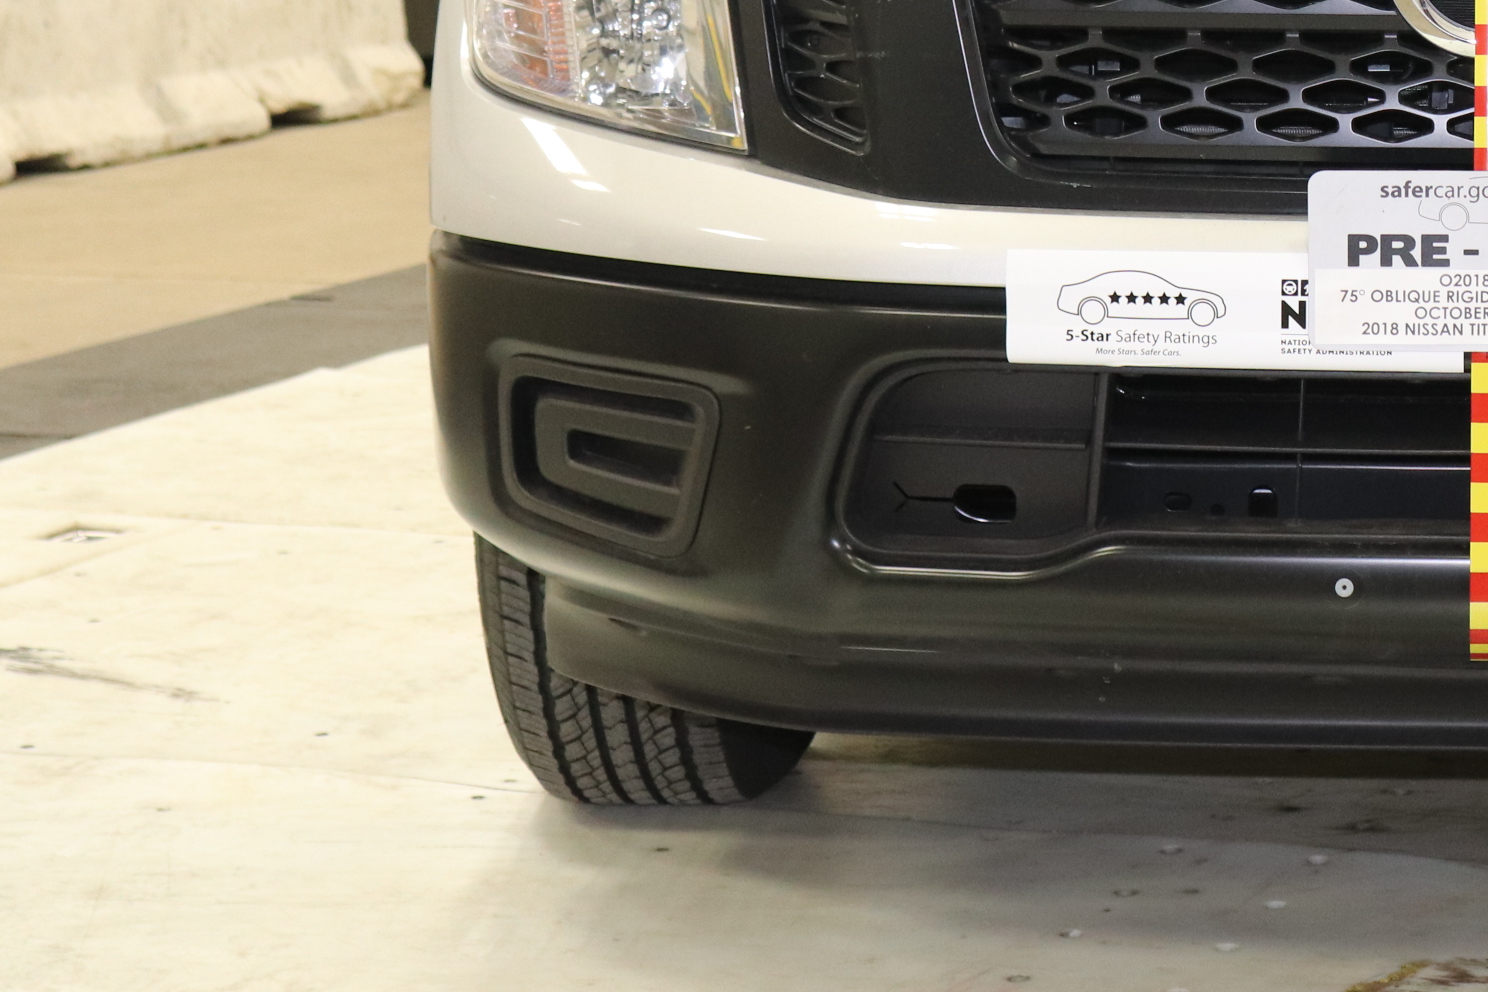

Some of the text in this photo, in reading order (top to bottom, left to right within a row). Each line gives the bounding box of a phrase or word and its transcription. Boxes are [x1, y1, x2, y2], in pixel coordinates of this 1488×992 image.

[1347, 234, 1450, 268] PRE
[1339, 289, 1366, 303] 75°
[1370, 290, 1443, 305] OBLIQUE
[1361, 322, 1399, 336] 2018
[1405, 323, 1464, 336] NISSAN
[1065, 329, 1218, 348] 5-Star Safety Ratings
[1095, 348, 1182, 357] More Stars. Safer Cars.
